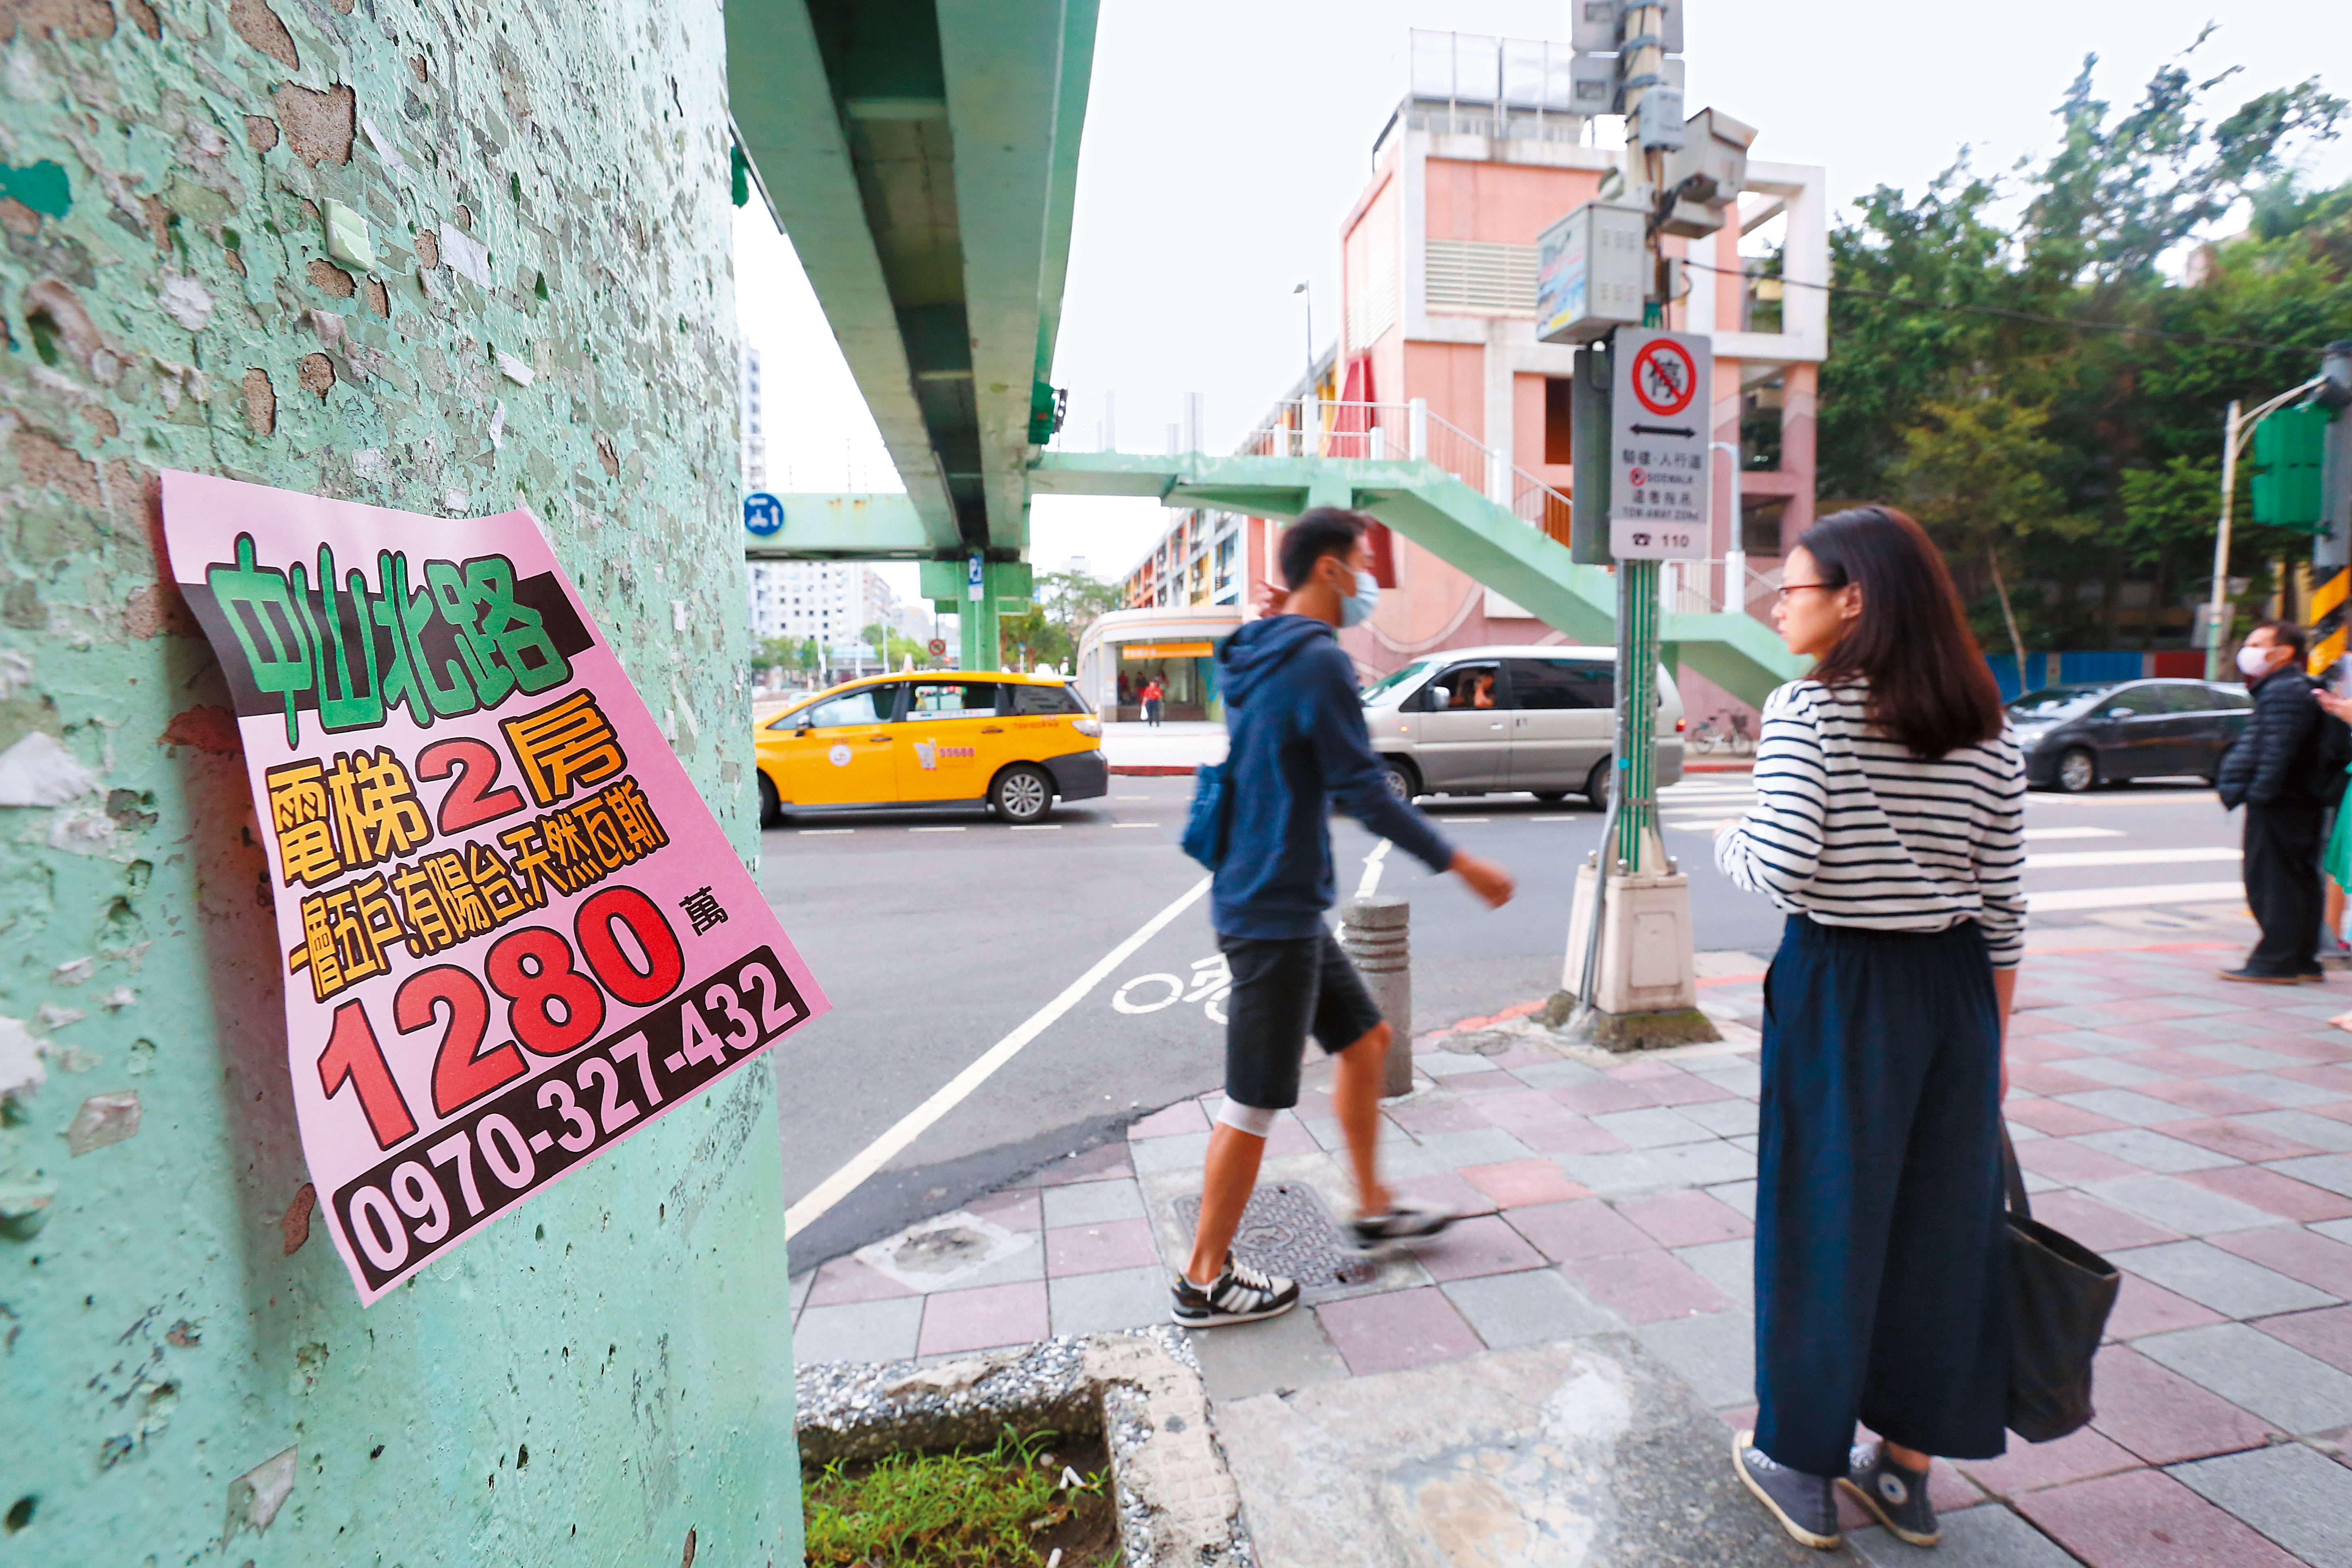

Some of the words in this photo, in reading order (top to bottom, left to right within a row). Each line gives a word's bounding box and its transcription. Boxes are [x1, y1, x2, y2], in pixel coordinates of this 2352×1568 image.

[207, 532, 572, 751] 中山北路
[1663, 534, 1690, 548] 110
[349, 962, 797, 1271] 0970-327-432
